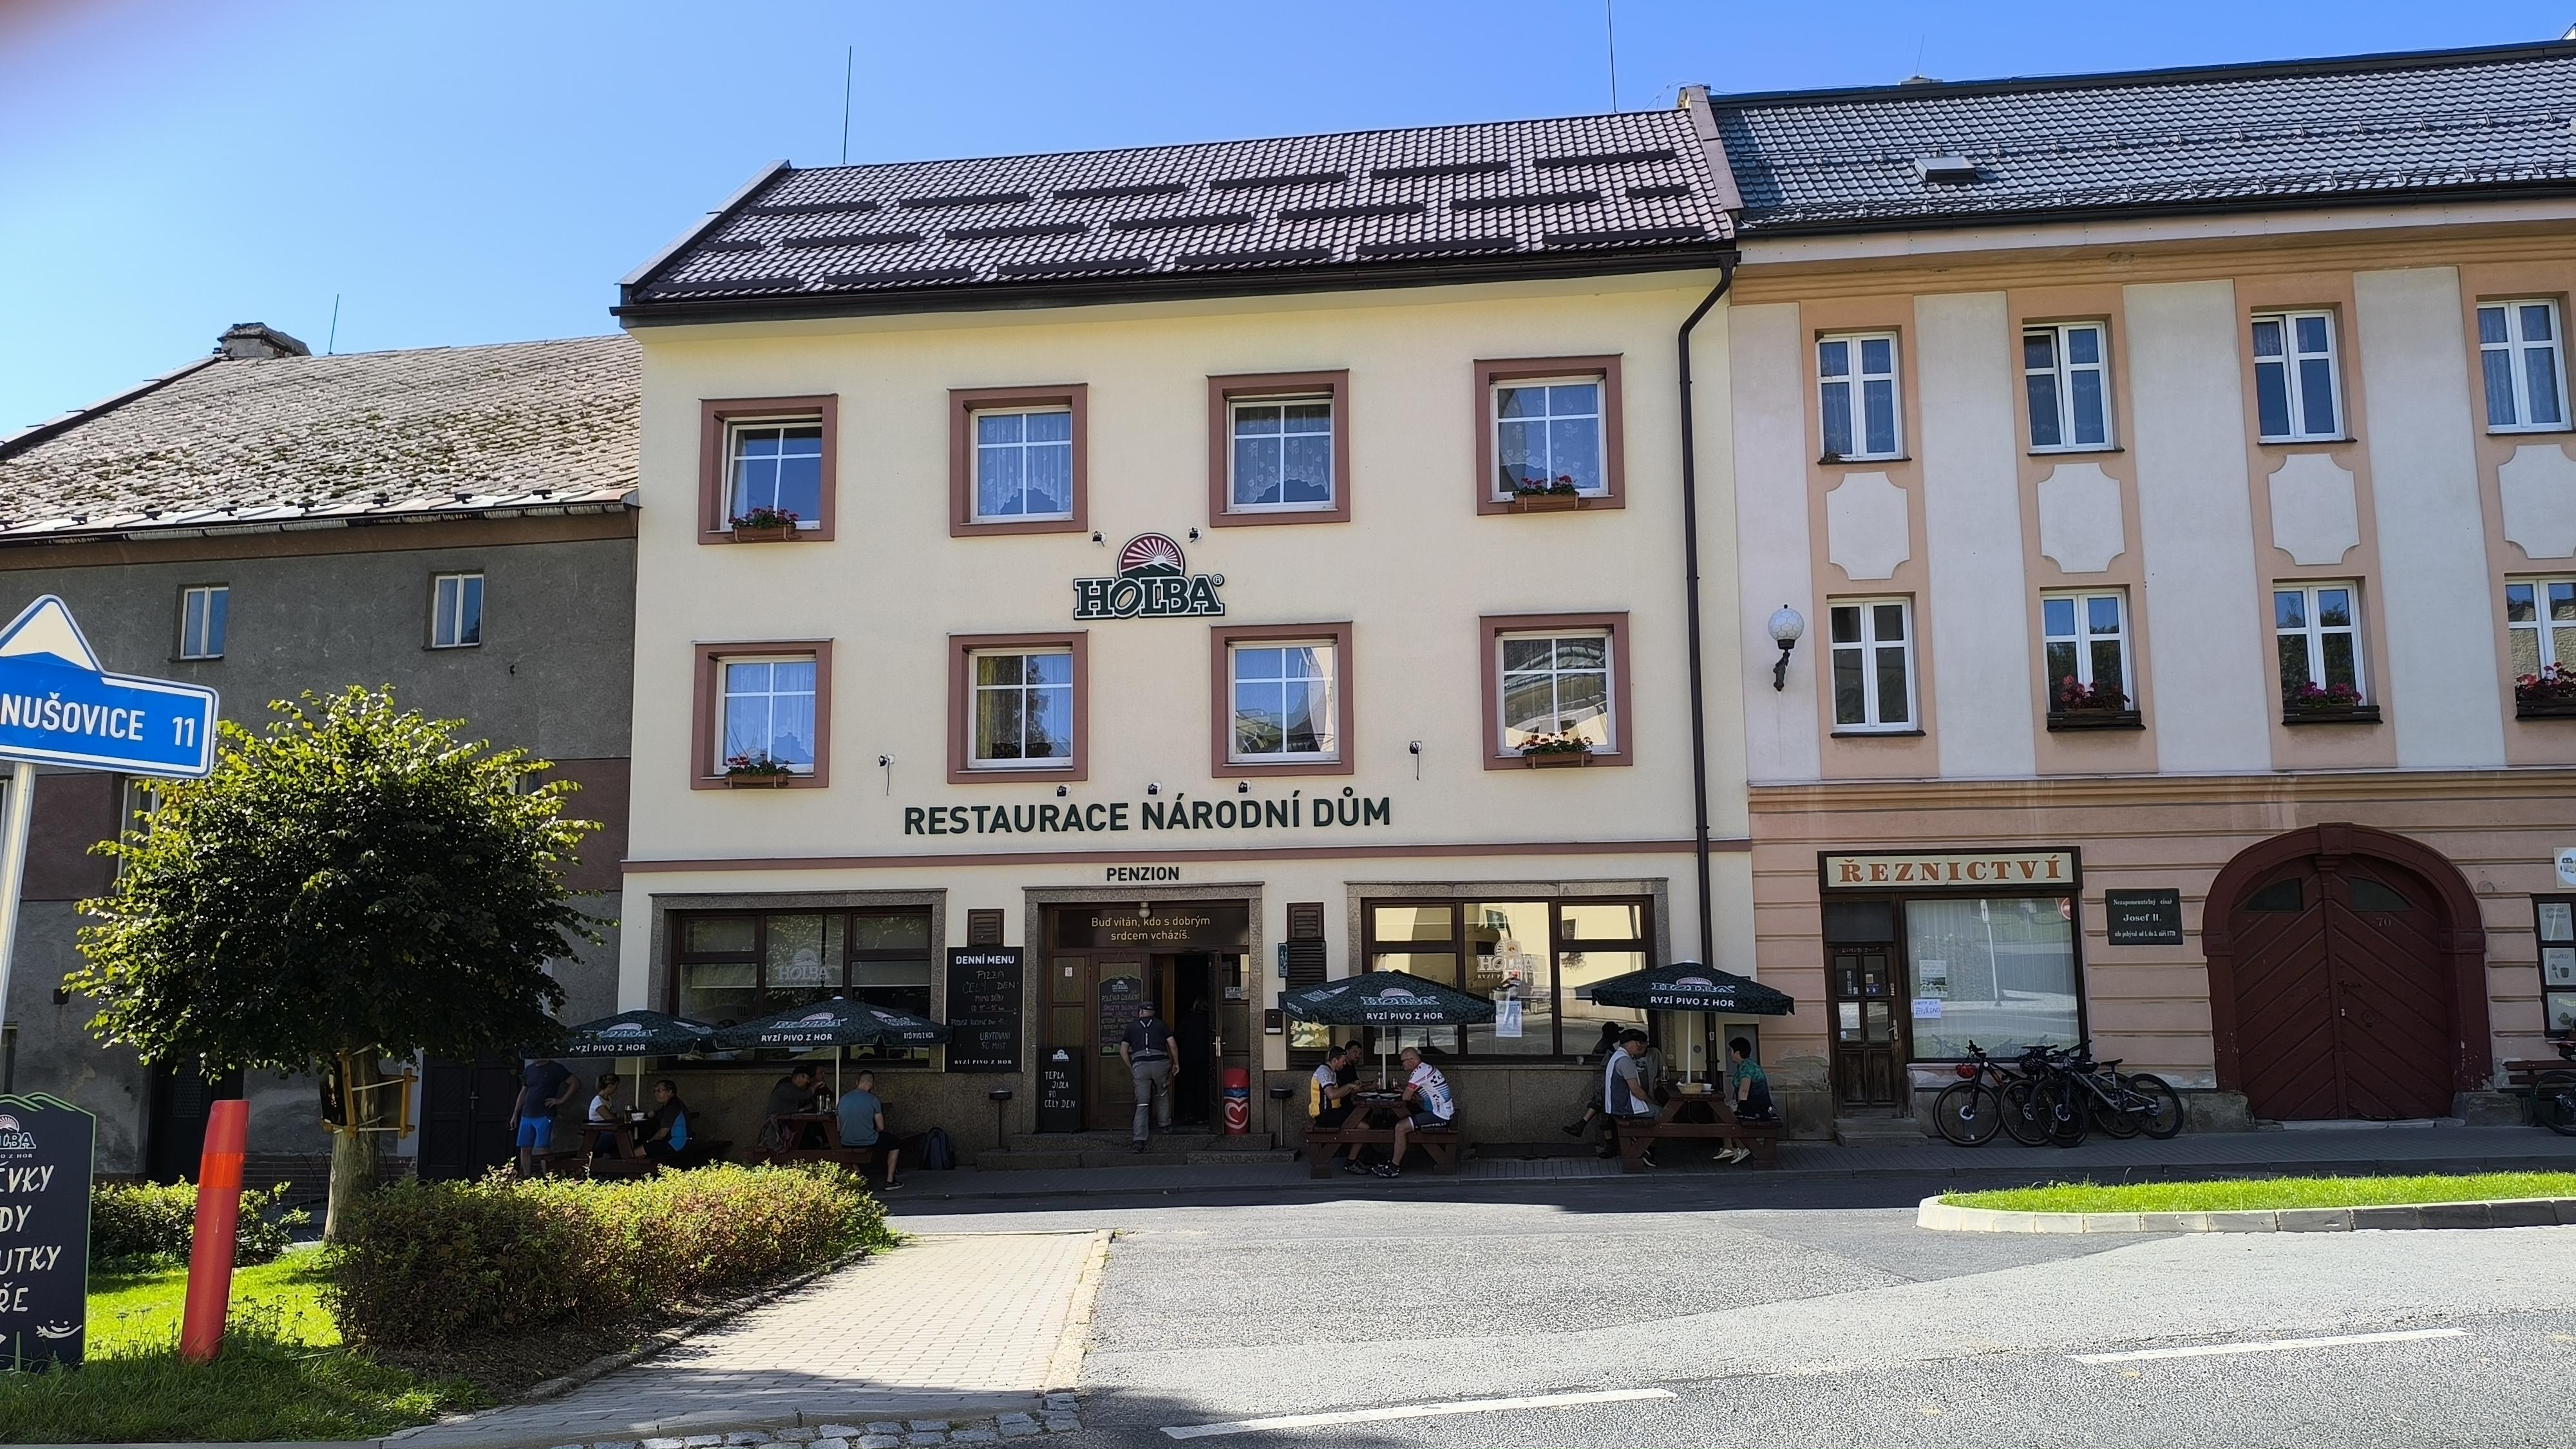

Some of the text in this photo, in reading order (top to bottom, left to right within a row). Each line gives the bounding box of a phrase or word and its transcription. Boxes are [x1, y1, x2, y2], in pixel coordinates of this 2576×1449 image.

[1074, 574, 1225, 620] HOLBA
[173, 716, 195, 747] 11
[904, 786, 1390, 835] RESTAURACE NÁRODNÍ DŮM
[1839, 854, 2061, 882] ŘEZNICTVÍ
[1106, 866, 1179, 882] PENZION
[1092, 917, 1113, 927] Buď
[1113, 916, 1141, 927] vítán,
[1143, 916, 1161, 926] kdo
[1172, 916, 1211, 927] dobrým
[2123, 913, 2162, 922] Josef II.
[2376, 917, 2391, 927] 70
[1110, 929, 1190, 941] srdcem vcházíš.
[956, 953, 1015, 965] DENNÍ MENU
[778, 965, 831, 980] HOLBA
[976, 971, 1005, 980] PIZZA
[1651, 995, 1674, 1005] RYZÍ
[1676, 997, 1700, 1005] PIVO
[1367, 1011, 1387, 1019] RYZÍ
[761, 1033, 782, 1042] RYZÍ
[1061, 1099, 1075, 1108] DEN
